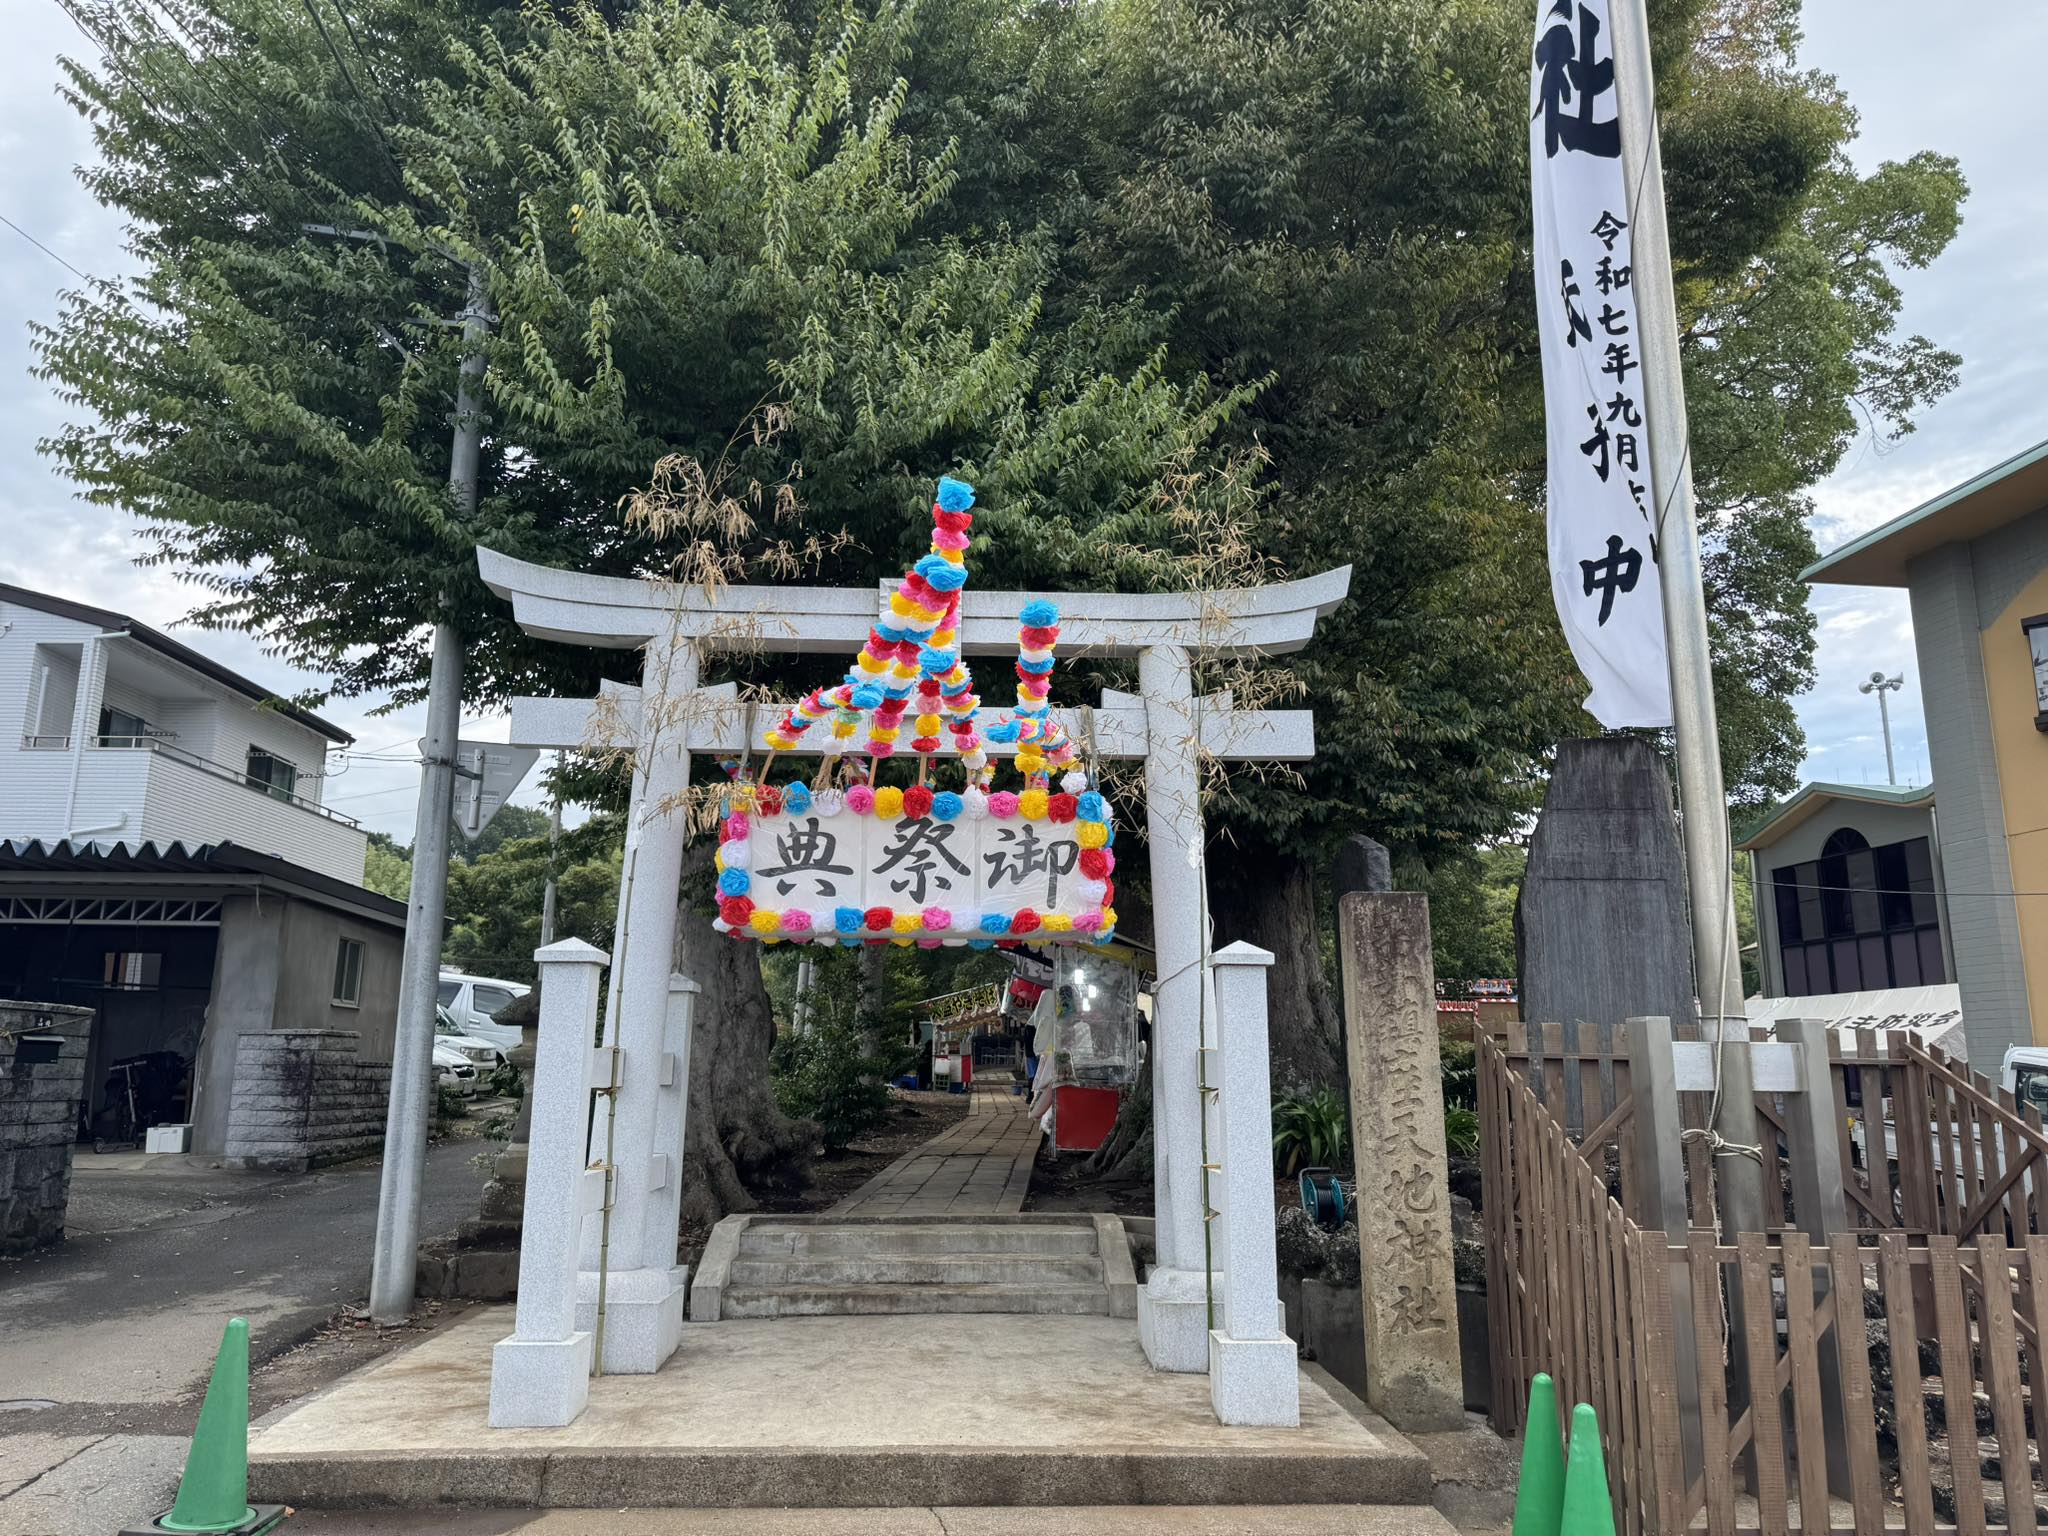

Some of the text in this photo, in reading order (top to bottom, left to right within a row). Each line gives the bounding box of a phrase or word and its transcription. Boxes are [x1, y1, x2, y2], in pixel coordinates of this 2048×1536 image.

[1531, 0, 1622, 159] 社
[1590, 211, 1658, 564] 令和七年九月
